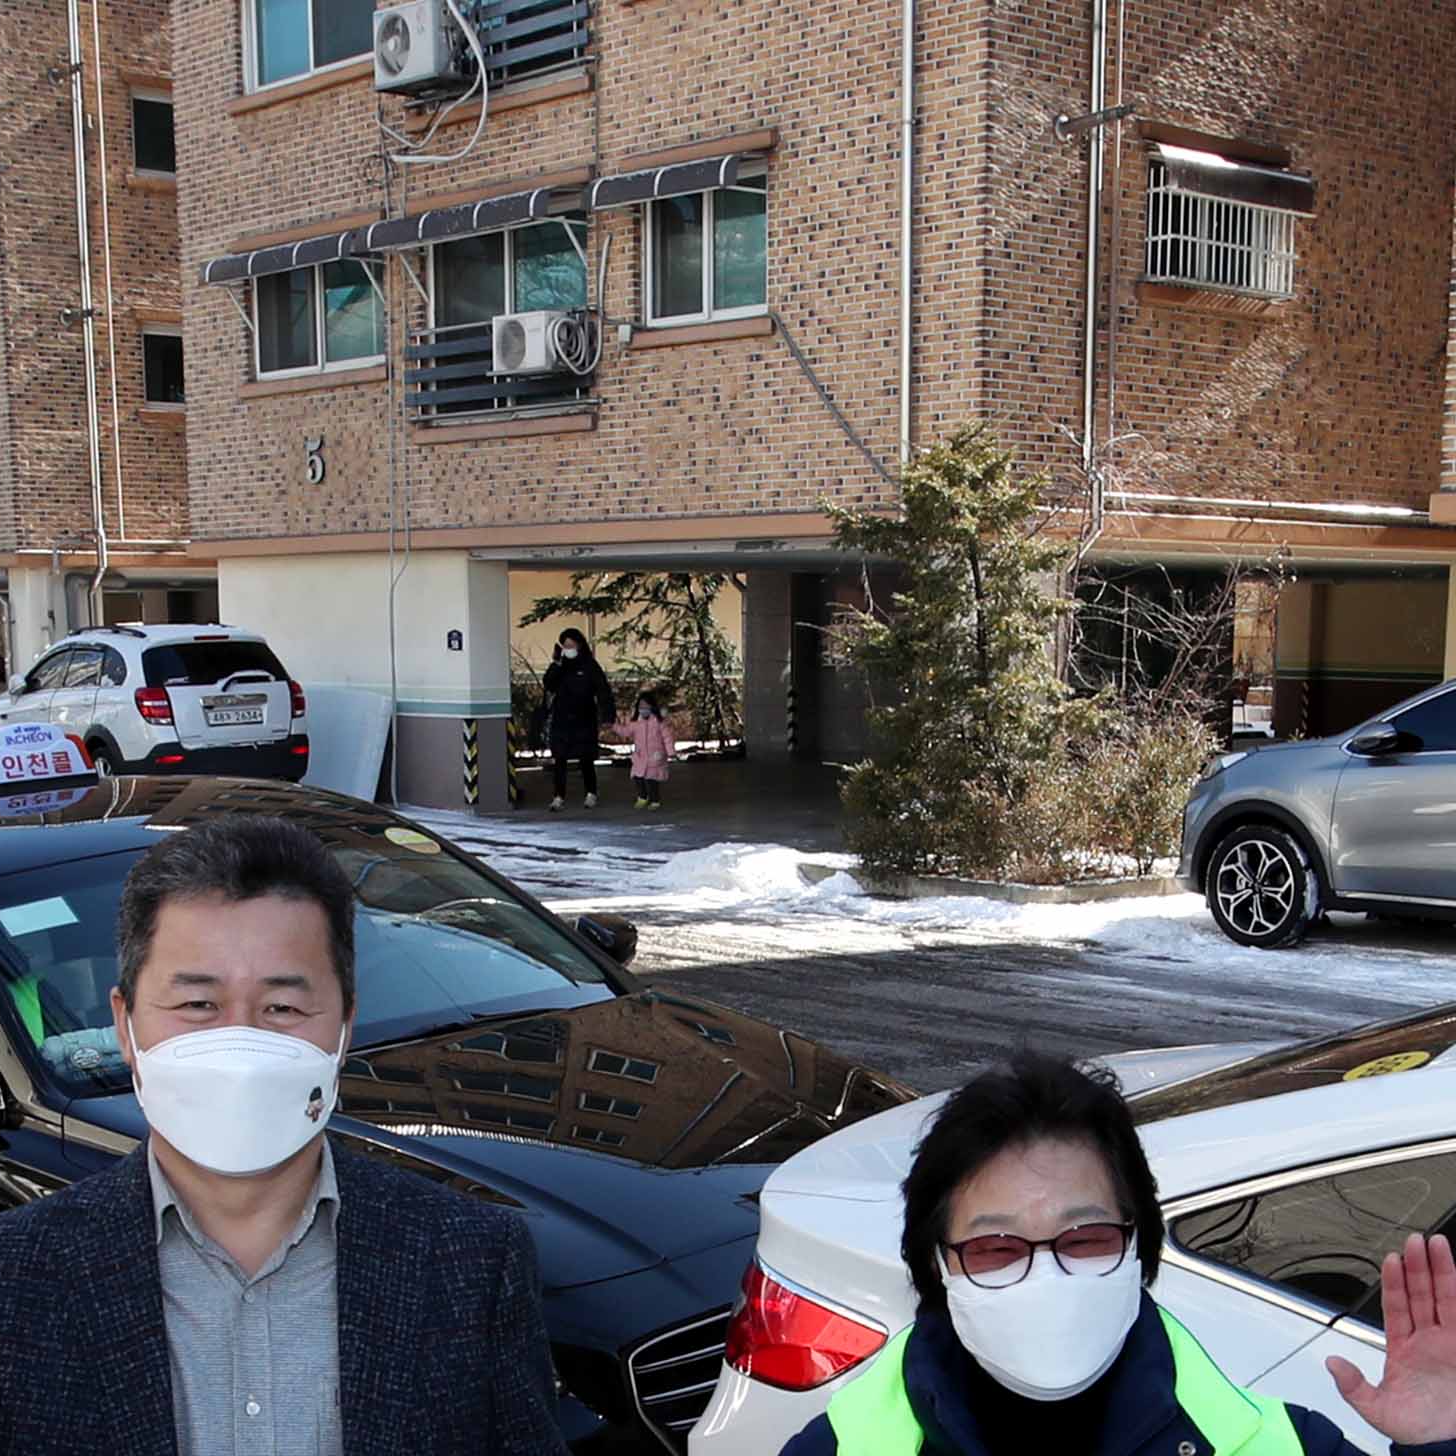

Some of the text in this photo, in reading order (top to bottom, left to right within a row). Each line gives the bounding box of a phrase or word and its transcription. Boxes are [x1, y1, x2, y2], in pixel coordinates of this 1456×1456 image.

[304, 434, 325, 485] 5
[5, 731, 53, 745] INCHEON
[1, 751, 73, 780] 인천콜
